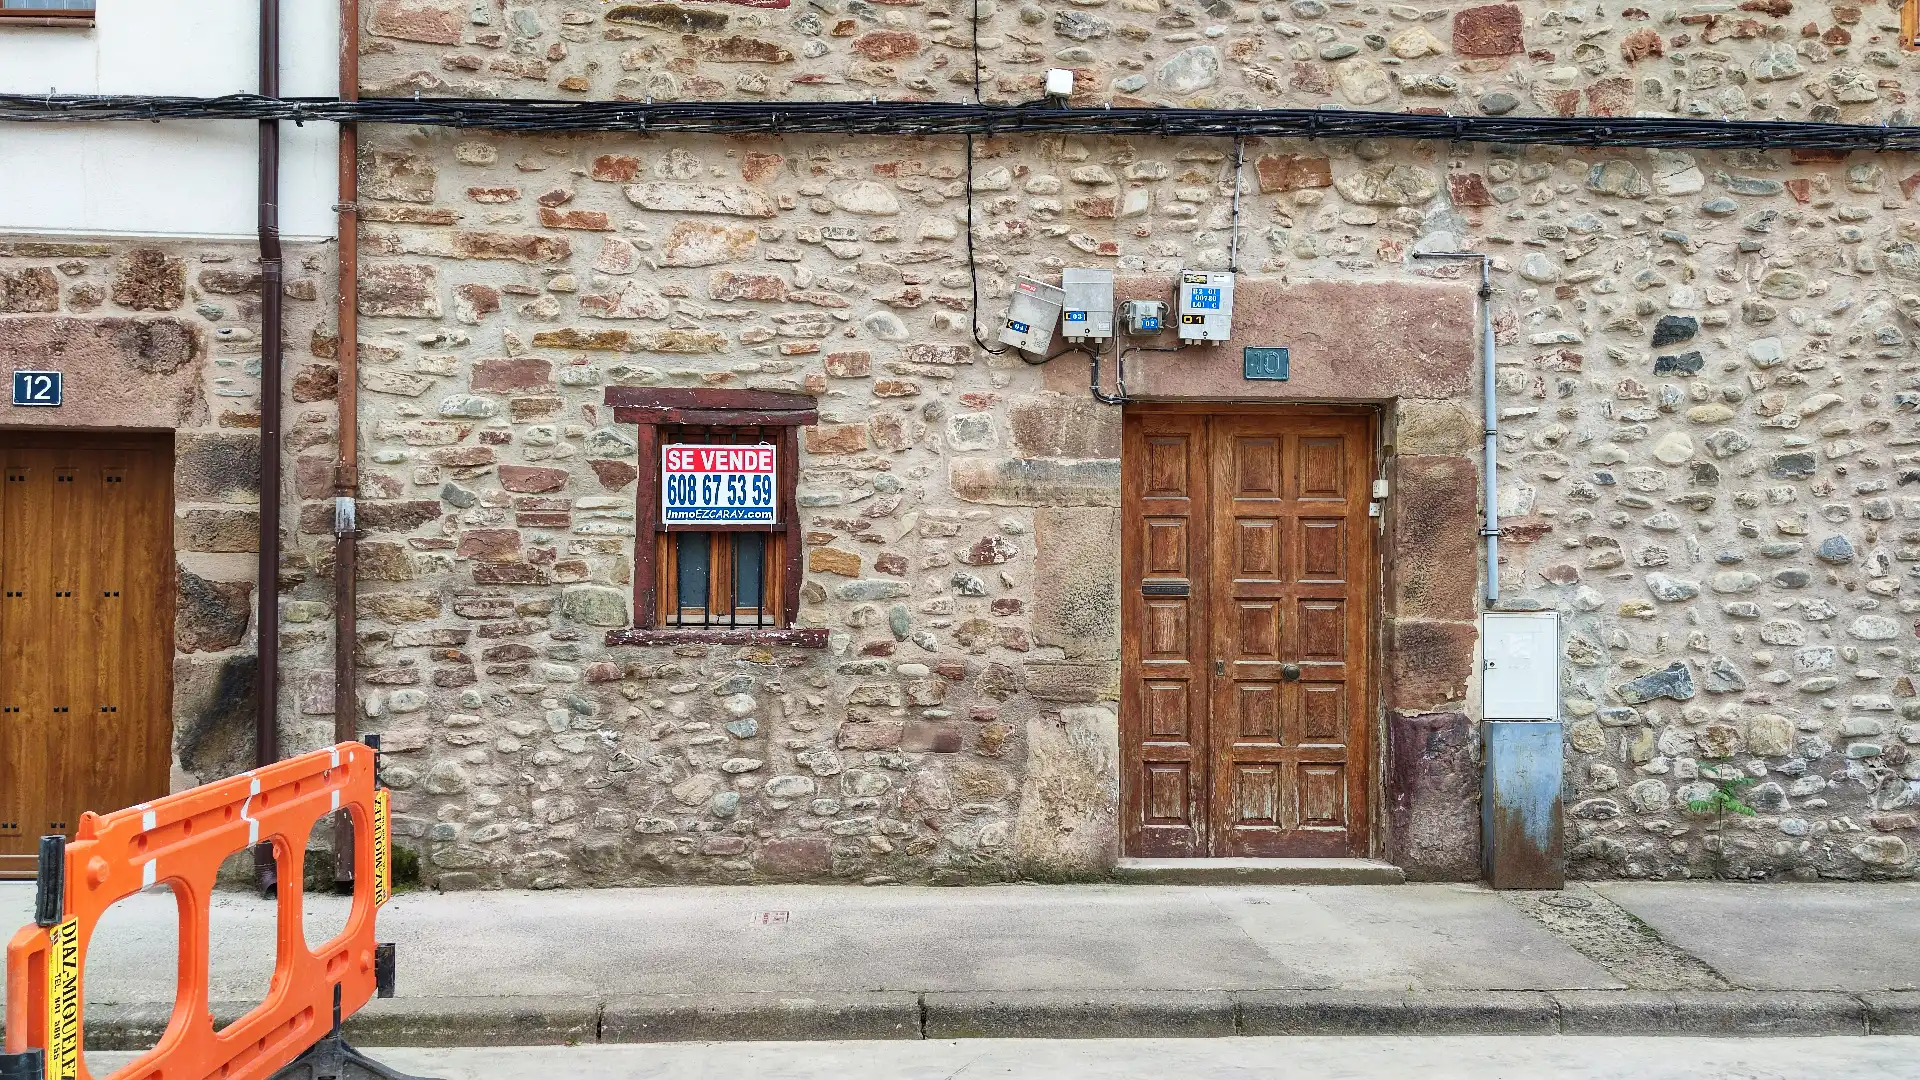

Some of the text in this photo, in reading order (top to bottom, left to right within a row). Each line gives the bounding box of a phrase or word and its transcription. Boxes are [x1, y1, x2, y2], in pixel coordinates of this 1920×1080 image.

[1183, 315, 1202, 324] 01
[1254, 350, 1280, 374] 10
[23, 375, 51, 400] 12
[667, 450, 772, 471] SE VENDE
[667, 474, 772, 505] 608 67 53 59
